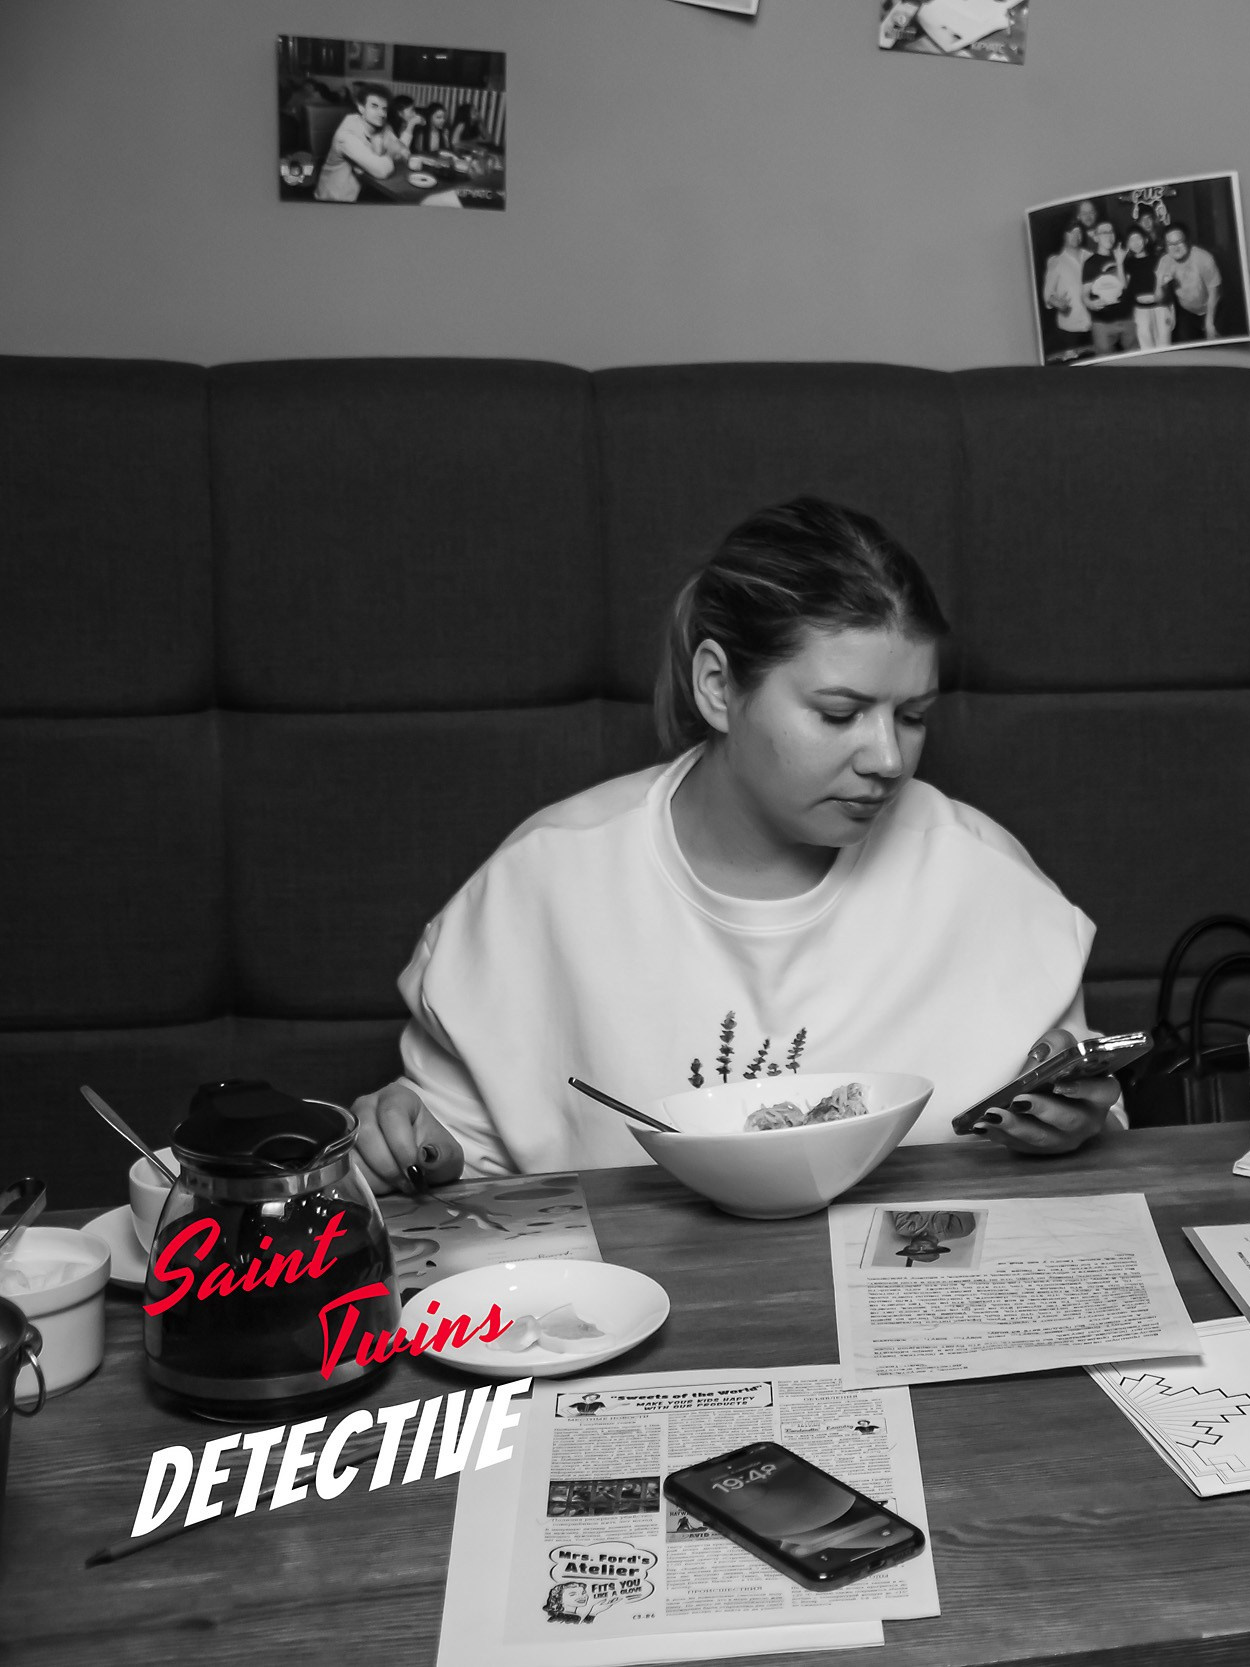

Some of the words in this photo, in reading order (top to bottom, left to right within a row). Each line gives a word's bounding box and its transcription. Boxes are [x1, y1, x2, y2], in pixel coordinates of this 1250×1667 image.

[610, 1393, 668, 1401] "Sweets
[672, 1391, 687, 1399] of
[692, 1390, 714, 1398] the
[717, 1385, 763, 1396] World"
[559, 1550, 594, 1561] Mrs.
[599, 1554, 650, 1565] Ford's
[564, 1562, 640, 1576] Atelier
[592, 1582, 616, 1593] FITS
[619, 1578, 641, 1589] YOU
[620, 1586, 642, 1595] GLOVE
